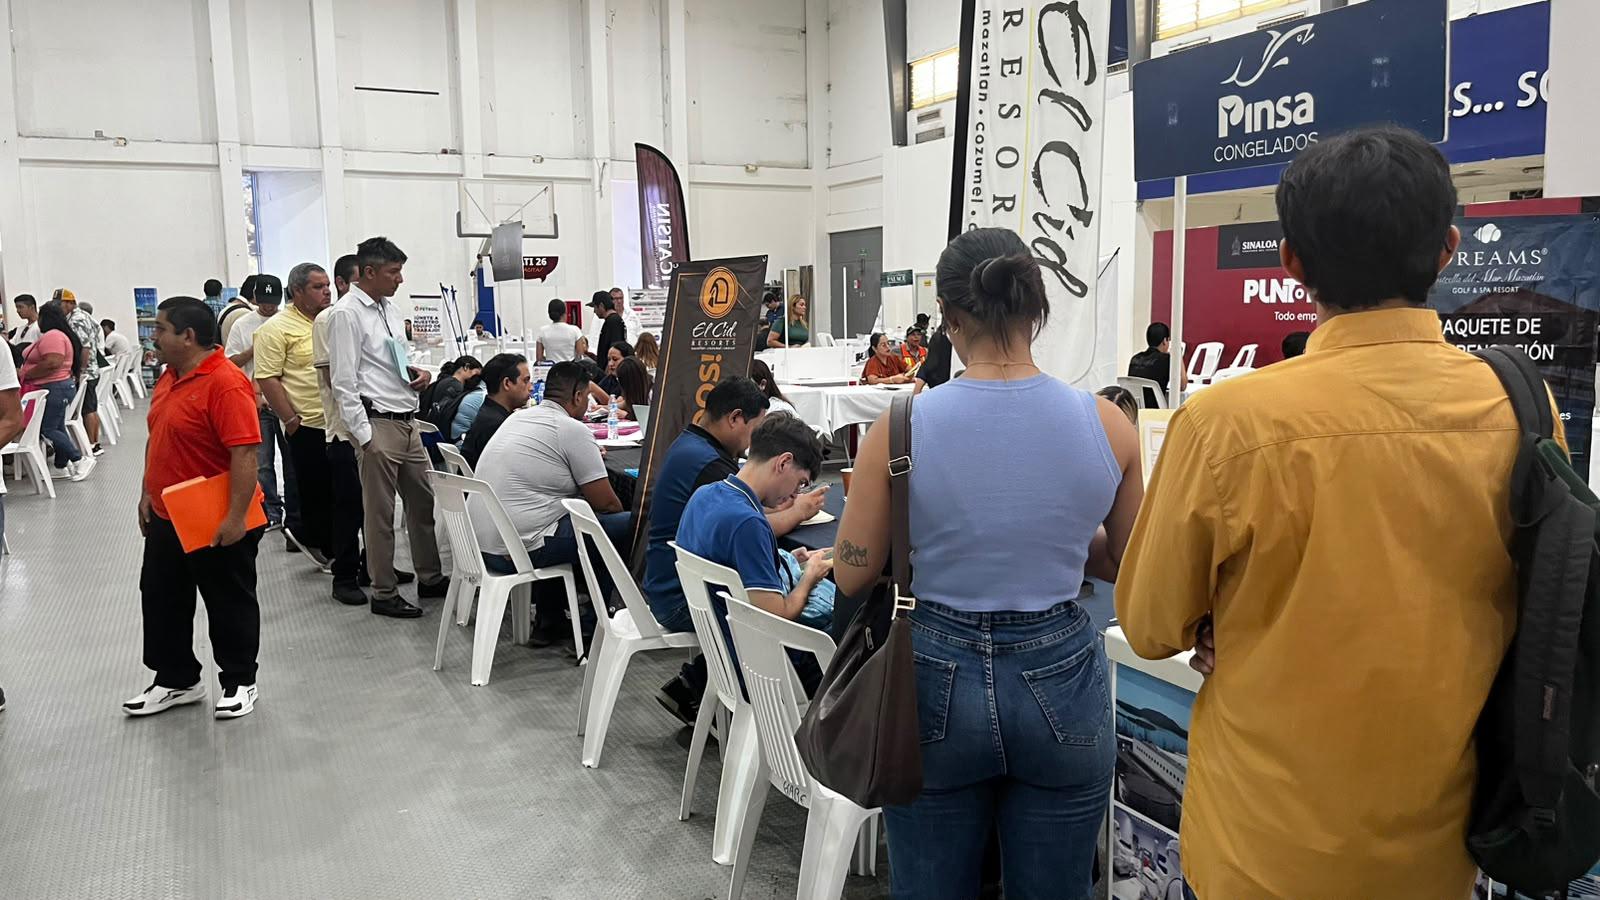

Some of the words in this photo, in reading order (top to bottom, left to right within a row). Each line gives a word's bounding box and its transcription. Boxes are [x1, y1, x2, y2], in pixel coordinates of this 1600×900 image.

[978, 10, 991, 102] mazatlan
[1038, 0, 1097, 132] El
[1218, 92, 1314, 138] Pinsa
[971, 121, 985, 203] cozumel
[1213, 131, 1319, 162] CONGELADOS
[1031, 141, 1093, 298] Cid
[1242, 240, 1278, 250] SINALOA
[535, 257, 547, 266] 26
[692, 322, 713, 338] El
[712, 321, 738, 338] Cid
[1274, 311, 1296, 321] Todo
[1516, 318, 1541, 335] DE
